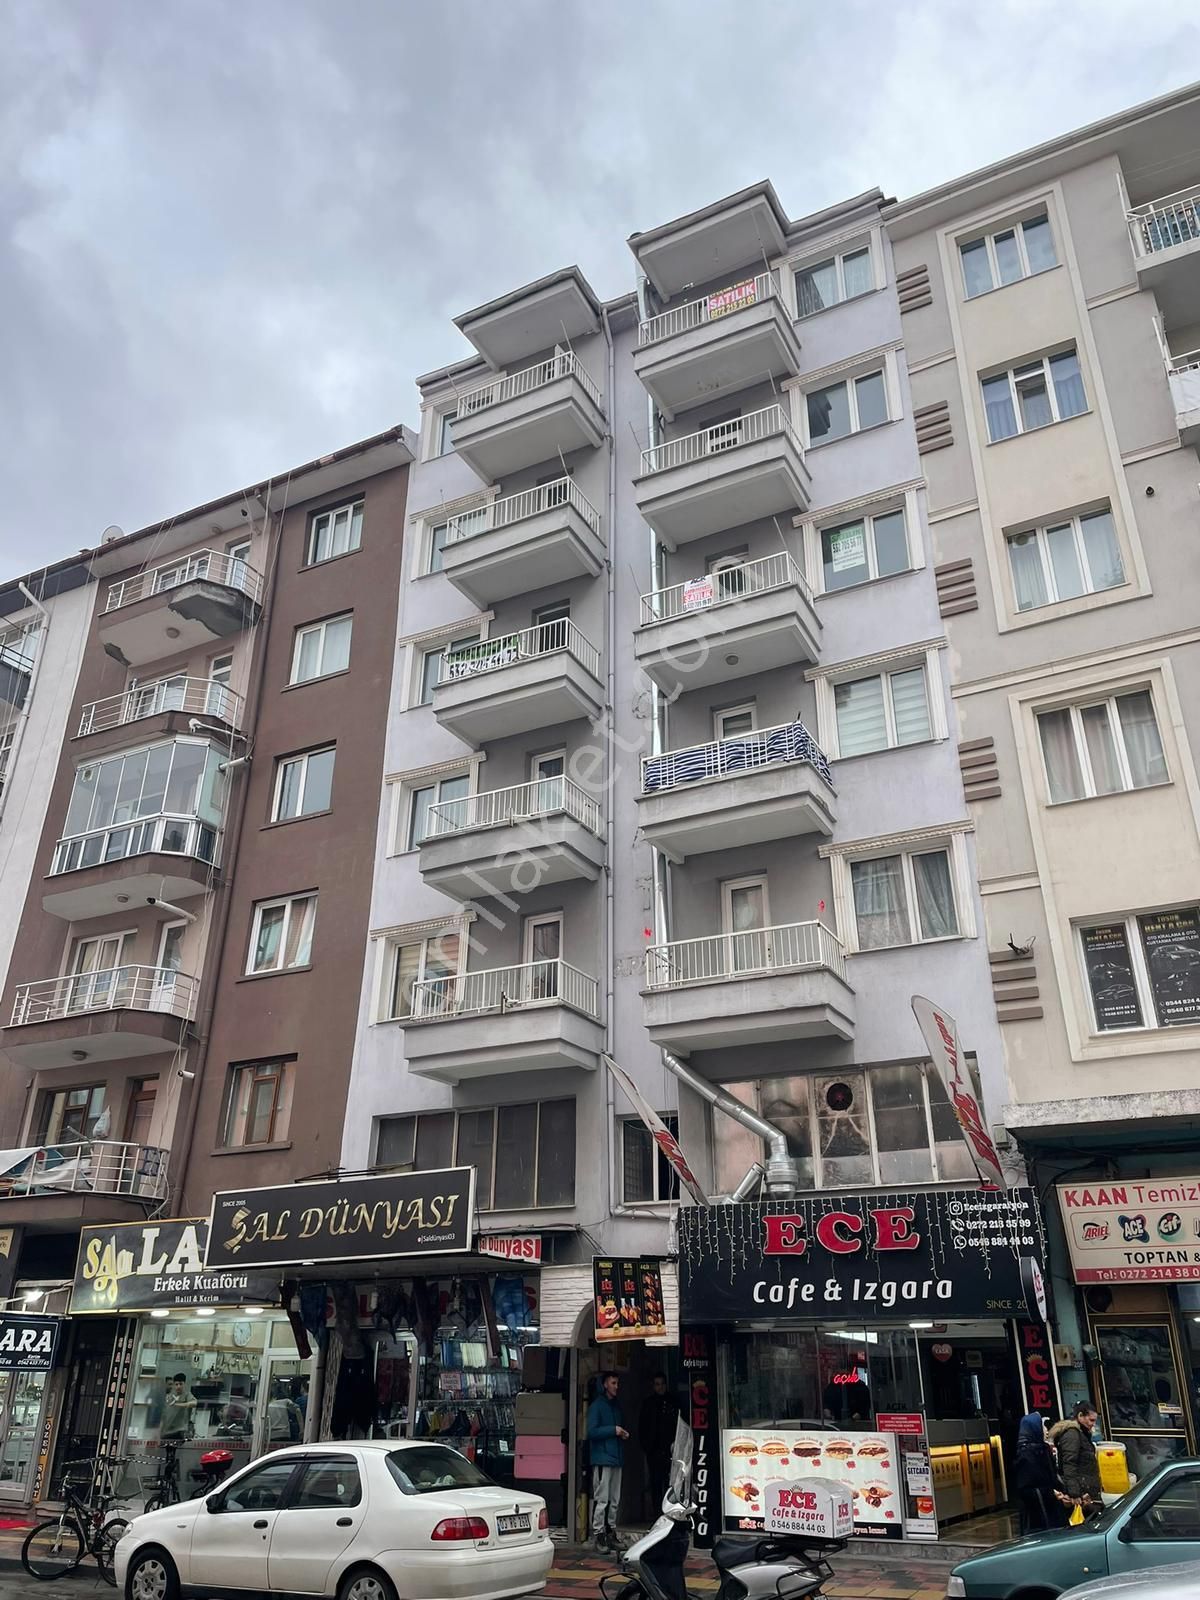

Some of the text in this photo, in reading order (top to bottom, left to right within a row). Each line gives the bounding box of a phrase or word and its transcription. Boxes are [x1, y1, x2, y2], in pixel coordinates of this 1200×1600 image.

[709, 282, 756, 310] SATILIK
[683, 589, 713, 604] SATILIK
[1064, 1187, 1128, 1208] KAAN
[298, 1194, 459, 1239] DÜNYASI
[966, 1220, 987, 1230] 0272
[1006, 1219, 1018, 1228] 35
[1020, 1218, 1031, 1228] 99
[1159, 1215, 1181, 1233] Cif
[762, 1207, 920, 1255] ECE
[1084, 1225, 1109, 1239] ARIEL
[1125, 1218, 1144, 1238] ACE
[489, 1235, 541, 1260] Dünyası
[968, 1237, 990, 1247] 0546
[991, 1237, 1008, 1246] 884
[1022, 1236, 1034, 1245] 03
[1124, 1250, 1188, 1264] TOPTAN
[153, 1272, 248, 1291] Erkek Kuaförü
[1097, 1270, 1117, 1280] Tel:
[1120, 1270, 1148, 1279] 0272
[1151, 1269, 1172, 1278] 214
[1175, 1269, 1189, 1278] 38
[753, 1278, 953, 1309] Cafe & Izgara
[986, 1300, 1012, 1309] SINCE
[1023, 1326, 1052, 1408] ECE
[907, 1467, 929, 1475] SETCARD
[33, 1464, 43, 1498] SAAT
[697, 1435, 708, 1535] Izgara
[779, 1490, 817, 1510] ECE
[739, 1519, 757, 1529] ECE
[772, 1508, 789, 1519] Cafe
[791, 1510, 797, 1518] &
[798, 1511, 824, 1522] Izgara
[771, 1520, 826, 1533] 0 546 884 44 03
